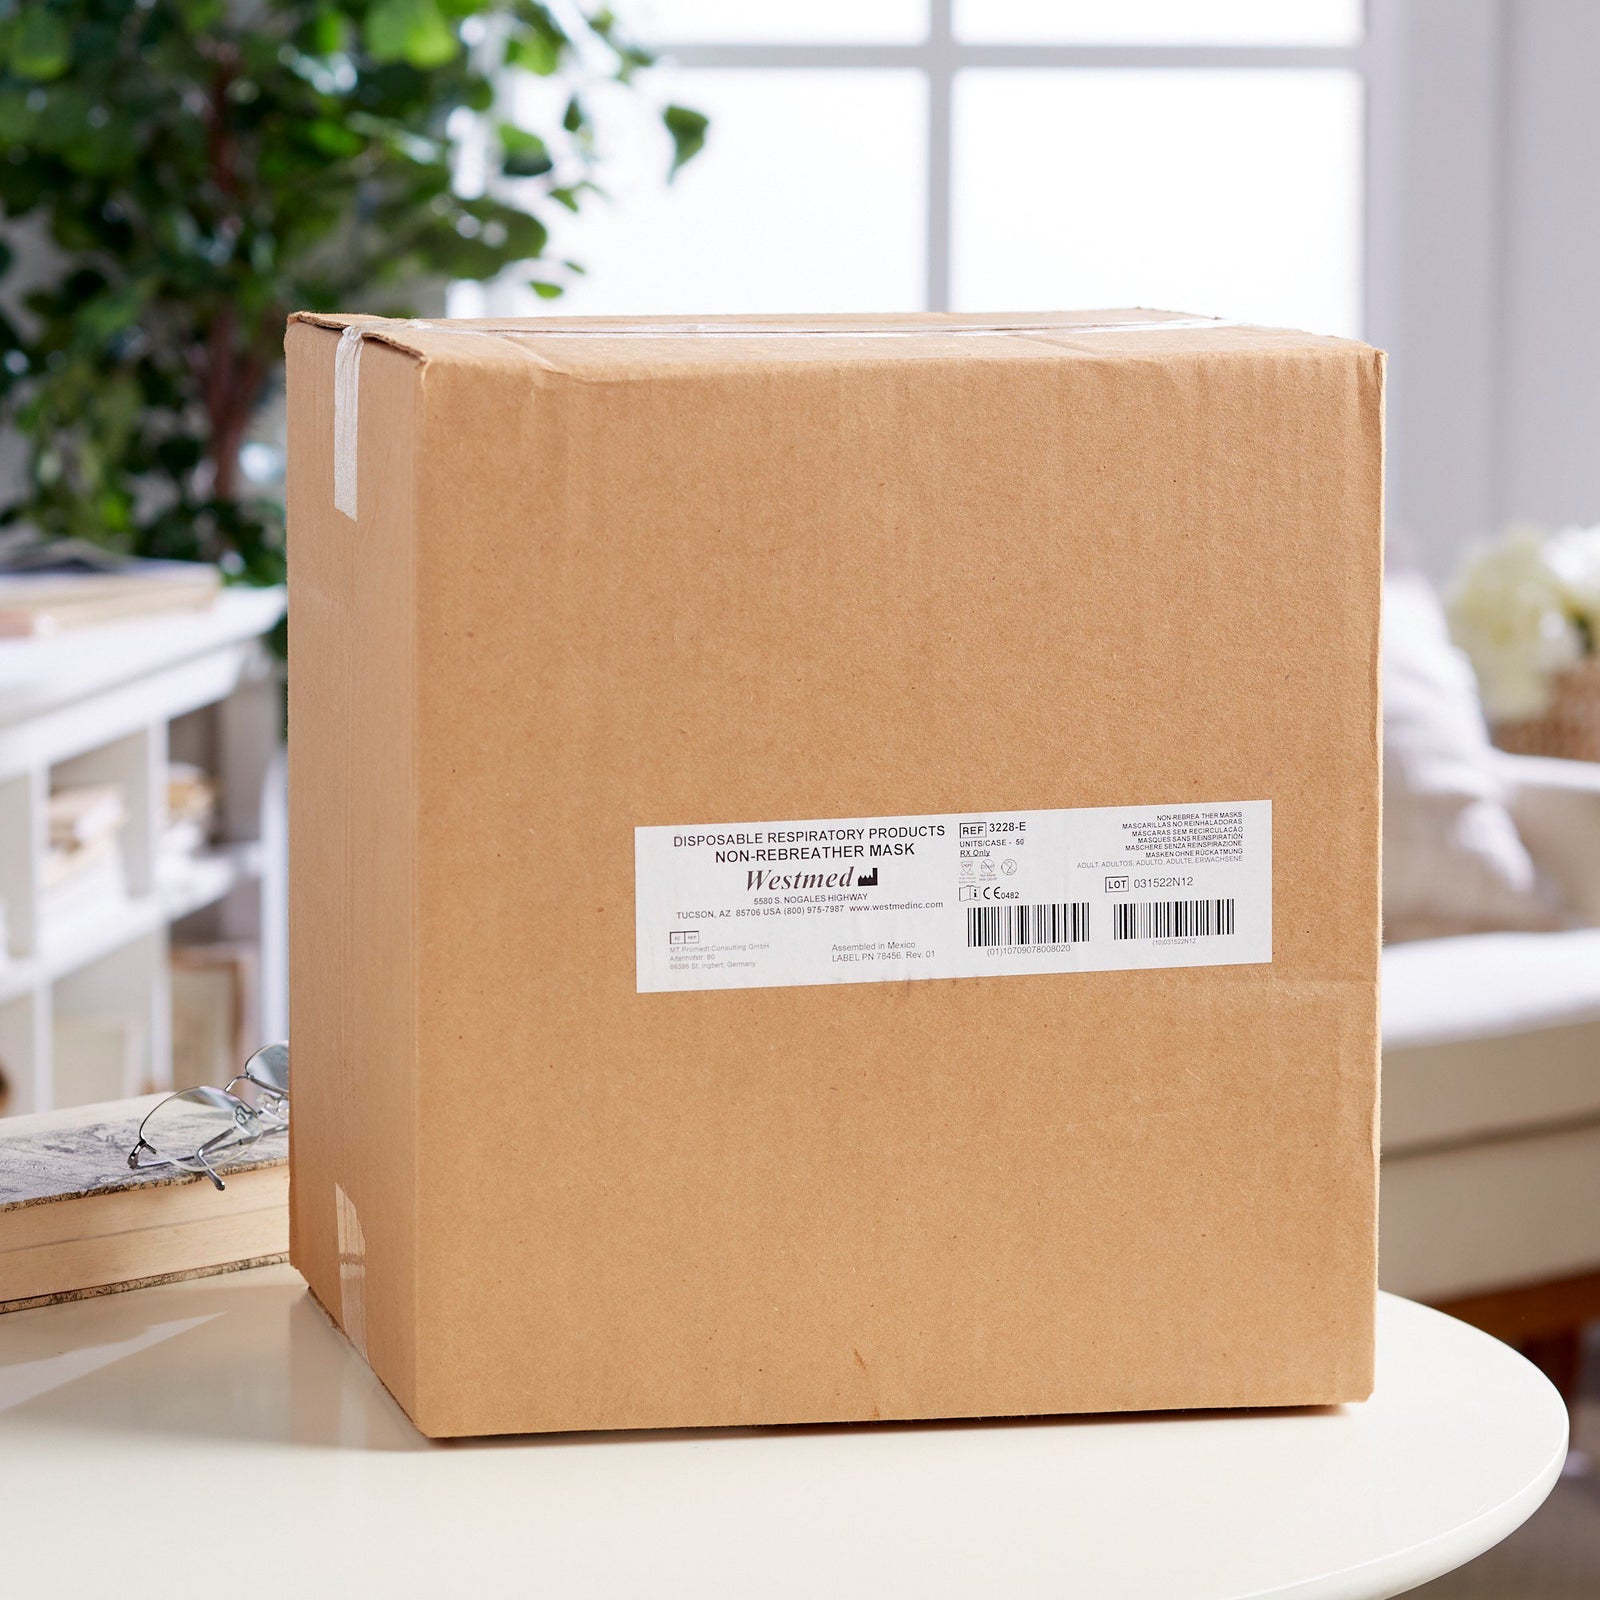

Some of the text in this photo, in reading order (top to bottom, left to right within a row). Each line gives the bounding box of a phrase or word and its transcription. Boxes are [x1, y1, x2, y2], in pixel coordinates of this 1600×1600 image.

[962, 822, 1026, 834] REF 3228-E
[1122, 820, 1171, 830] MASCARILLAS
[1184, 818, 1242, 826] REINHALADORAS
[673, 825, 945, 848] DISPOSABLE RESPIRATORY PRODUCTS
[960, 840, 1006, 848] UNITS/CASE
[1188, 840, 1242, 848] REINSPIRAZIONE
[716, 842, 915, 863] NON-REBREATHER MASK
[973, 850, 990, 858] Only
[1195, 856, 1243, 864] ERWACHSENE
[746, 866, 854, 891] Westmed
[1108, 877, 1194, 888] LOT 031522N12
[754, 897, 772, 905] 5580
[784, 895, 826, 904] NOGALES
[828, 893, 868, 902] HIGHWAY
[676, 902, 944, 919] TUCSON, AZ 85706 USA (800) 975-7987 www.westmedinc.com
[832, 941, 916, 951] Assembled in Mexico
[987, 944, 1071, 956] (01)10709078008020
[832, 954, 860, 962] LABEL
[926, 950, 935, 958] 01
